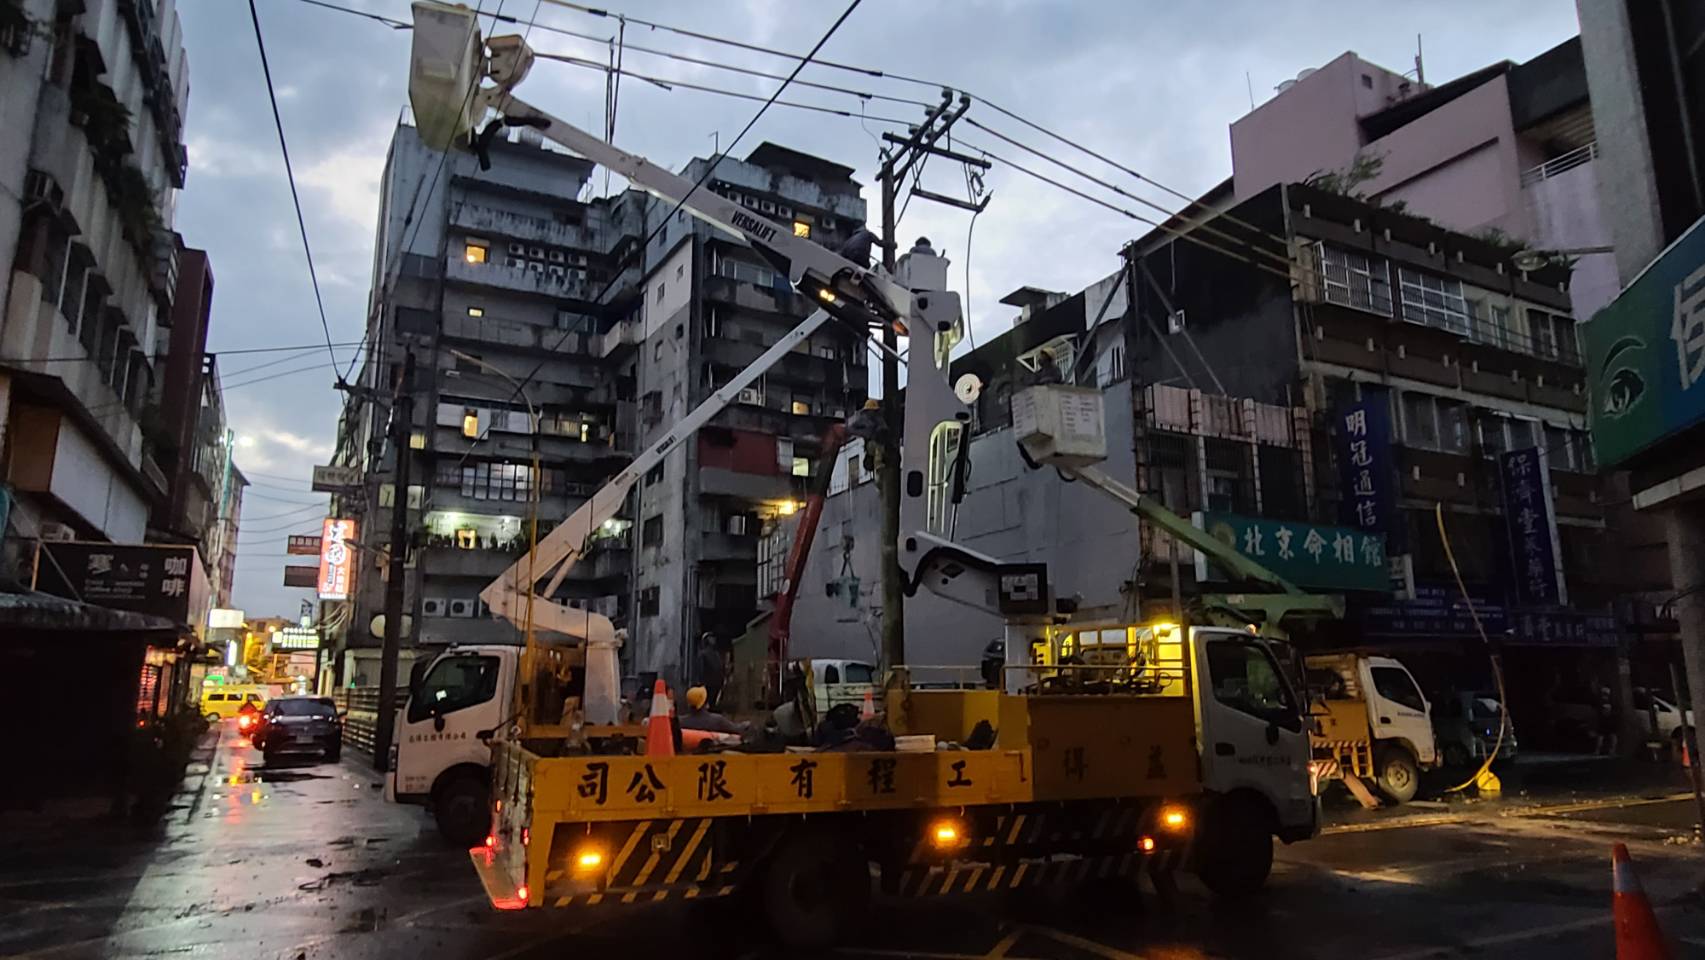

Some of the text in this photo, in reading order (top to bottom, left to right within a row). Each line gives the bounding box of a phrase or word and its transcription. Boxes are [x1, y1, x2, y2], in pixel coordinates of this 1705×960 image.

[731, 210, 777, 242] VERSALIFT
[1344, 408, 1378, 528] 明冠通信
[1243, 523, 1384, 568] 北京命相館
[161, 556, 187, 597] 咖啡
